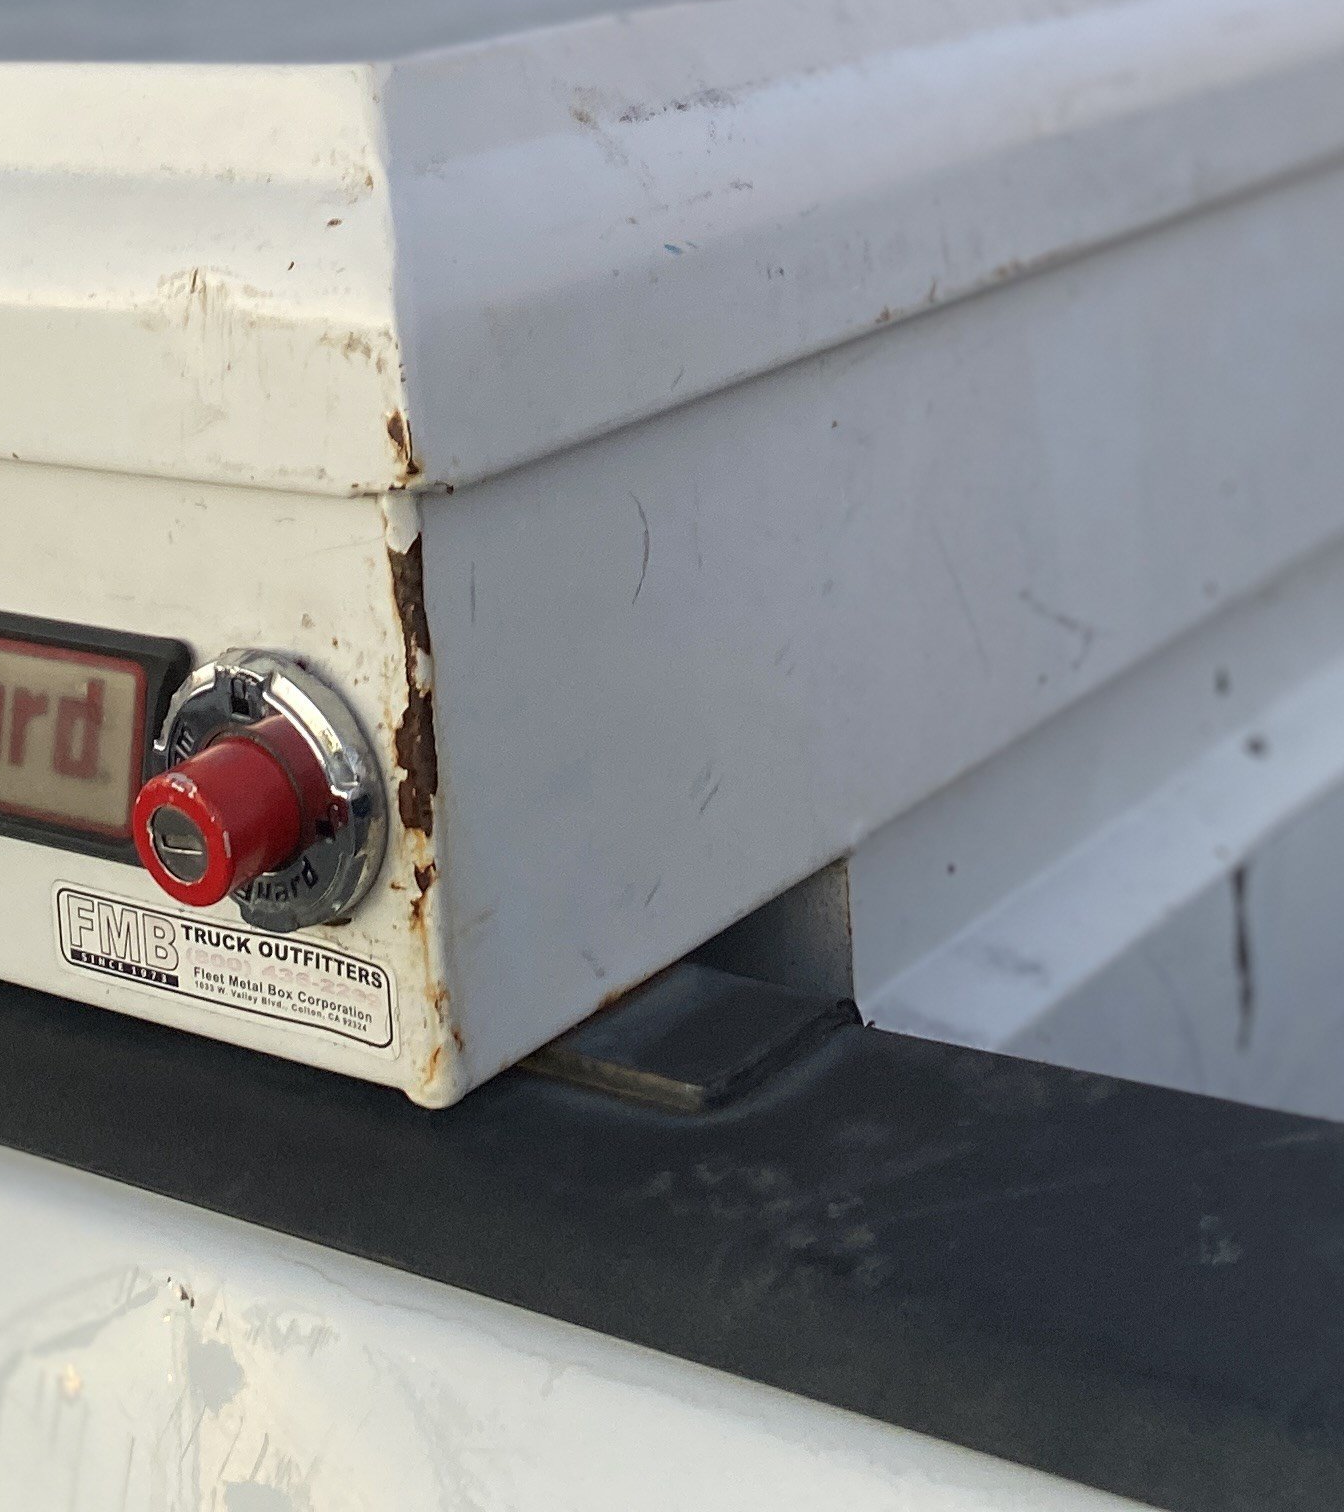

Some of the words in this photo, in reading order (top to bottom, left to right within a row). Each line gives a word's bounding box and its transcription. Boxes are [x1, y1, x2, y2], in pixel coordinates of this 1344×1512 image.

[67, 893, 179, 972] FMB
[81, 952, 124, 972] SINCE
[180, 923, 252, 955] TRUCK
[258, 940, 383, 989] OUTFITTERS
[193, 966, 225, 985] Fleet
[229, 974, 263, 994] Metal
[268, 983, 294, 1000] Box
[298, 991, 372, 1023] Corporation
